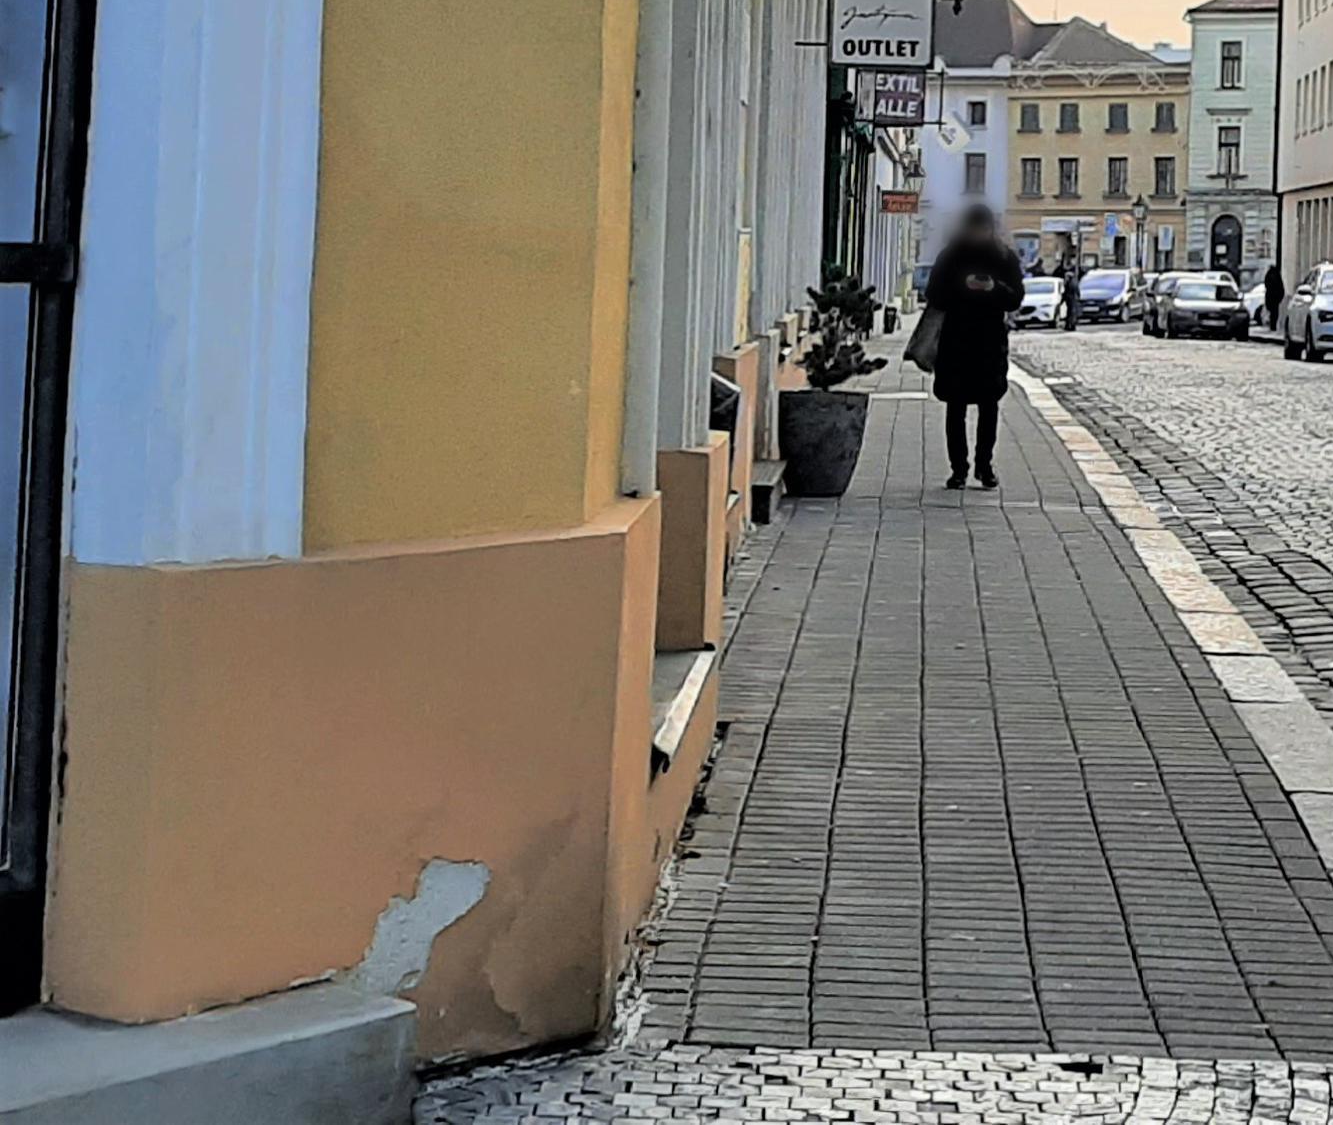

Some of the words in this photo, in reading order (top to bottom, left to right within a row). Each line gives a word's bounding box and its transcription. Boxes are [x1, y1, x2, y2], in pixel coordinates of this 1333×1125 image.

[842, 39, 920, 58] OUTLET
[875, 74, 920, 93] EXTIL
[875, 99, 919, 118] ALLE
